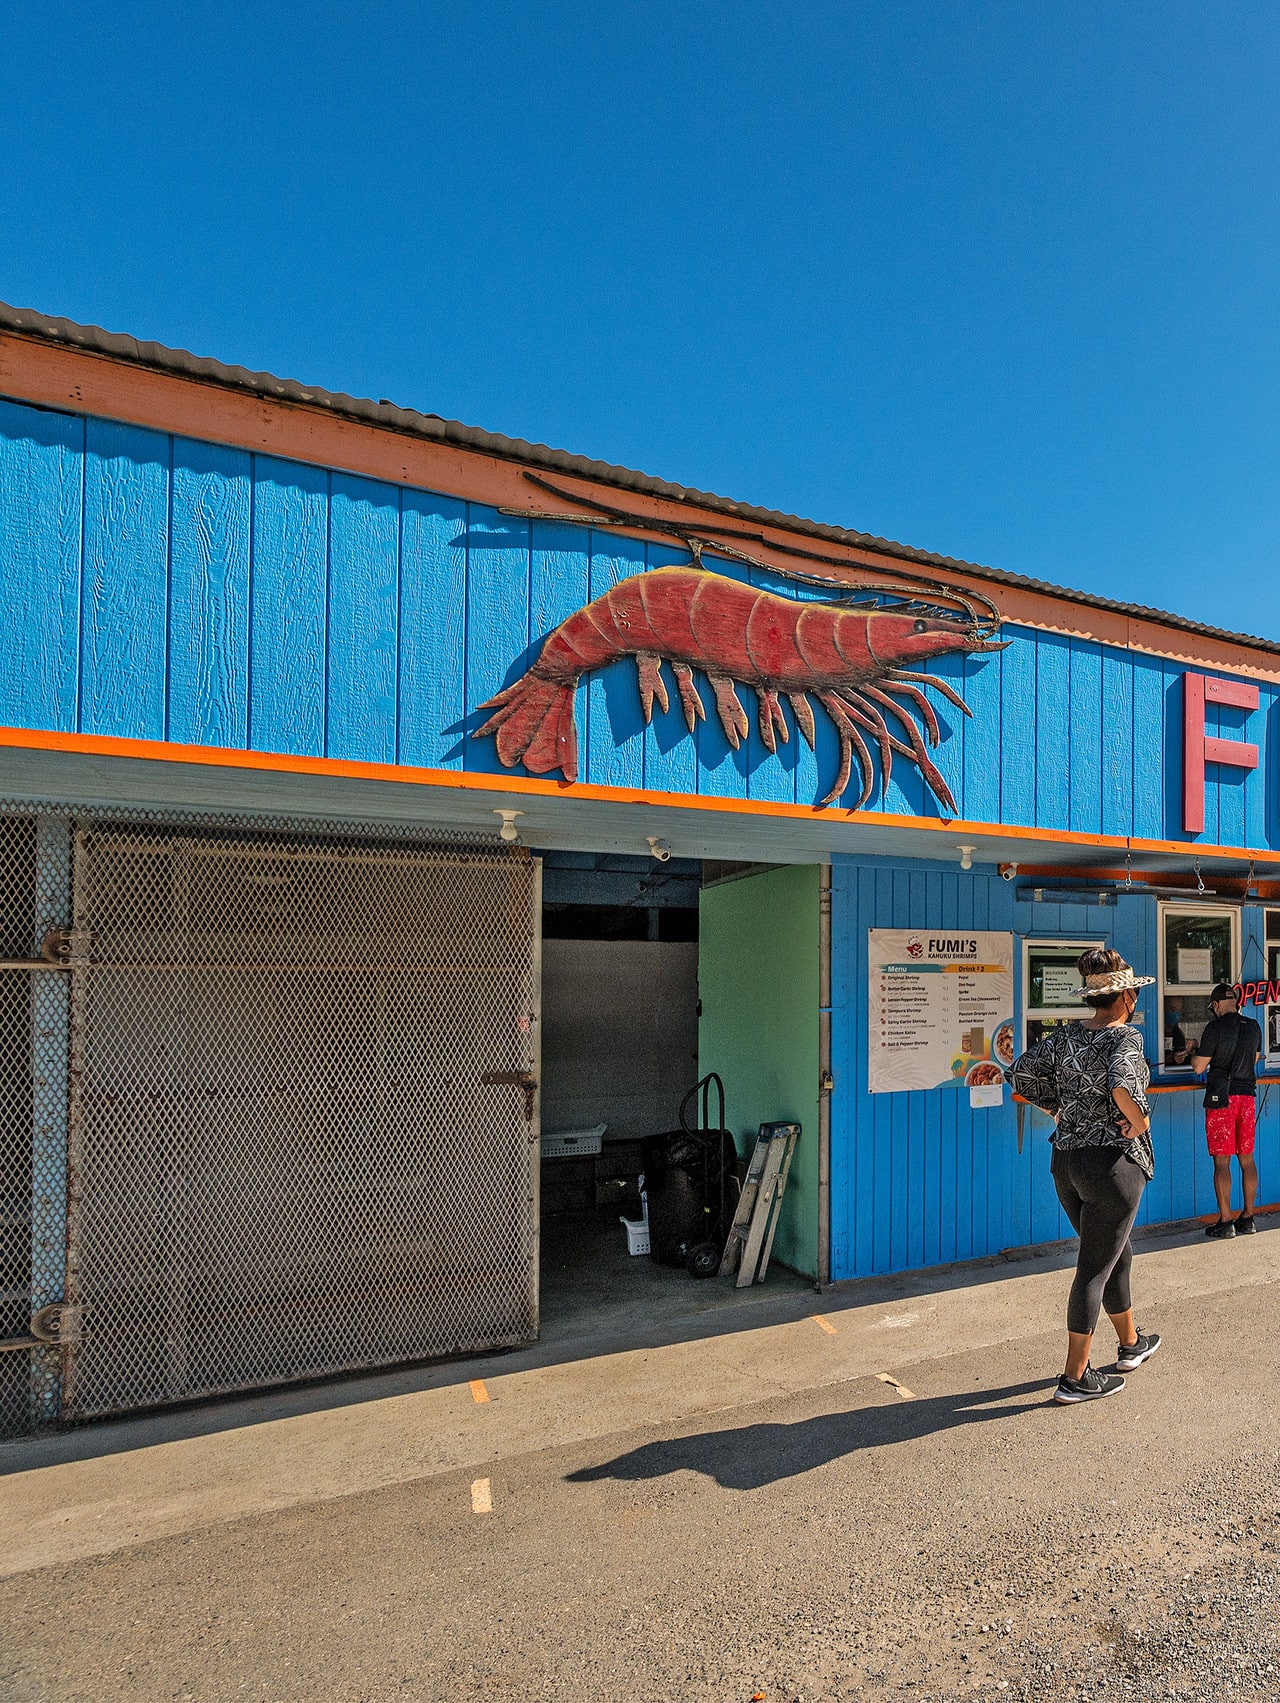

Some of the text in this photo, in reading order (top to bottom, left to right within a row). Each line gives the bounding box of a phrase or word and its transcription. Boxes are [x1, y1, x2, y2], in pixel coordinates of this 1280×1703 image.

[928, 939, 977, 953] FUMI'S
[887, 965, 908, 973] Menu
[958, 965, 976, 973] Drink
[1232, 978, 1280, 1007] OPEN
